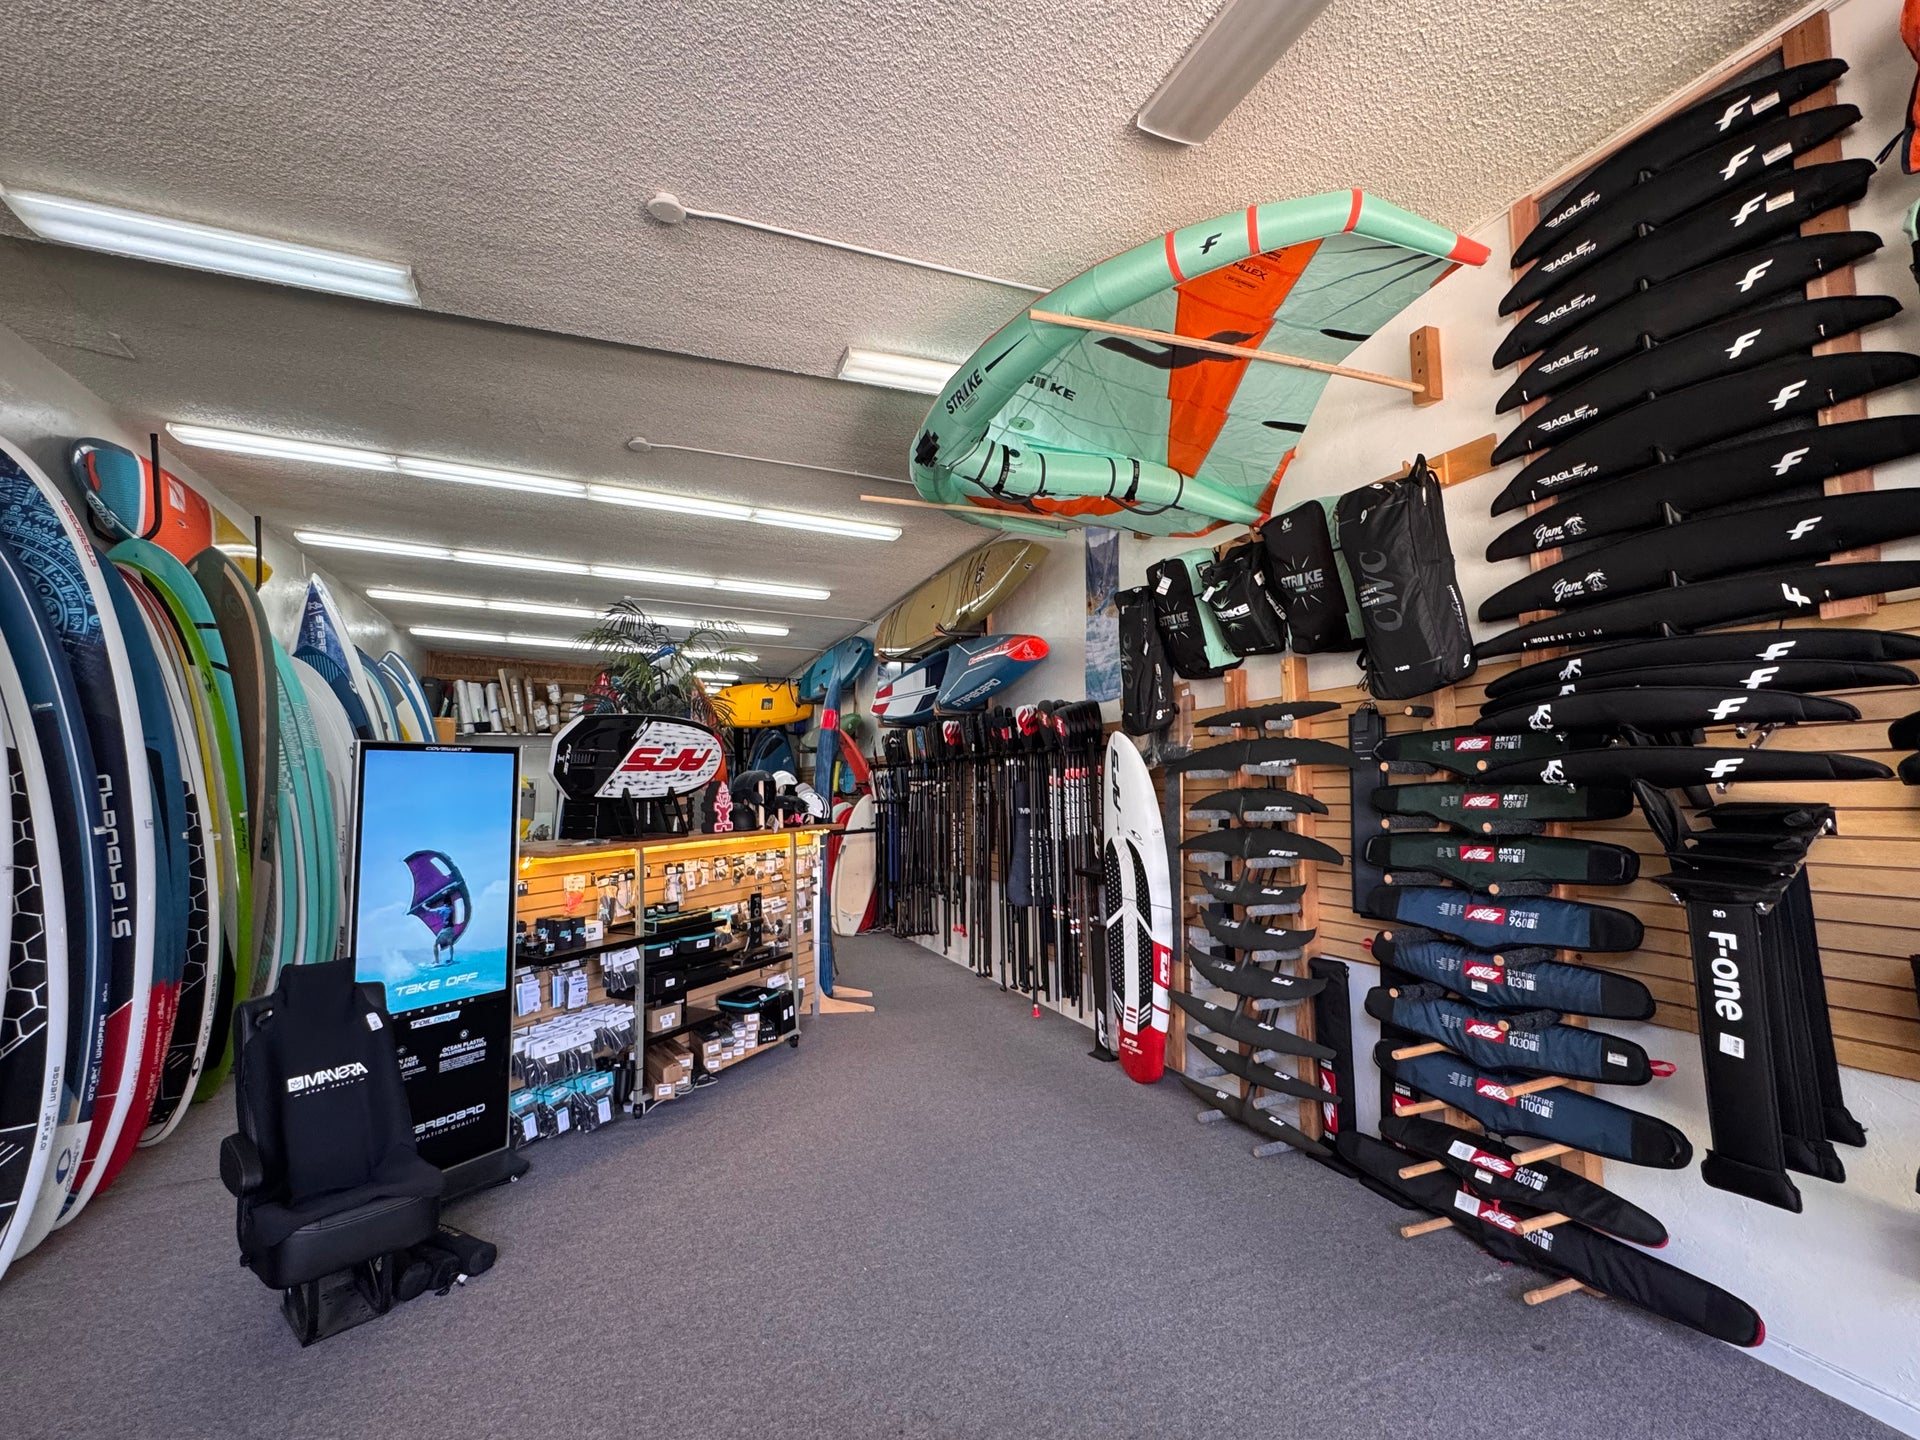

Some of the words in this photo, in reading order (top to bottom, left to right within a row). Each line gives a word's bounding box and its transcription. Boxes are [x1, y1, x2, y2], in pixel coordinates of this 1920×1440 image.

[1545, 191, 1595, 227] EAGLE
[1541, 240, 1590, 272] EAGLE
[1535, 294, 1585, 325] EAGLE
[1539, 345, 1588, 374] EAGLE
[945, 368, 983, 415] STRIKE
[1537, 404, 1589, 431] EAGLE
[1537, 462, 1587, 486] EAGLE
[1360, 510, 1368, 524] 9
[1535, 524, 1563, 548] Jam
[1281, 568, 1324, 588] STRIKE
[1359, 550, 1404, 632] CWC
[1554, 580, 1583, 602] Jam
[1159, 611, 1189, 627] STRIKE
[1530, 629, 1603, 644] MOMENTUM
[1463, 653, 1471, 668] 9
[1457, 738, 1488, 750] AXIS
[621, 748, 713, 772] AFS
[1464, 795, 1497, 807] AXIS
[1463, 848, 1492, 859] AXIS
[1467, 908, 1502, 921] AXIS
[1509, 917, 1527, 928] 960
[1510, 910, 1540, 919] SPITFIRE
[1466, 966, 1500, 980] AXIS
[1708, 931, 1743, 1021] F-one
[396, 979, 441, 997] TAKE
[445, 972, 479, 987] OFF
[1507, 976, 1526, 988] 1030
[95, 1014, 106, 1058] WHOPPER
[1467, 1025, 1502, 1038] AXIS
[1508, 1030, 1540, 1041] SPITFIRE
[442, 1043, 462, 1053] OCEAN
[463, 1037, 485, 1047] PLASTIC
[1508, 1036, 1529, 1049] 1030
[400, 1059, 419, 1069] LANET
[304, 1062, 369, 1088] MANERA
[50, 1066, 60, 1102] WEDGE
[1479, 1085, 1510, 1100] AXIS
[1521, 1093, 1555, 1108] SPITFIRE
[1520, 1099, 1540, 1114] 1100
[412, 1103, 486, 1134] ARBOARD
[415, 1126, 448, 1142] OVATION
[451, 1116, 481, 1130] QUALITY
[1473, 1156, 1512, 1172] AXIS
[1514, 1172, 1535, 1187] 1001
[1480, 1210, 1516, 1229] AXIS
